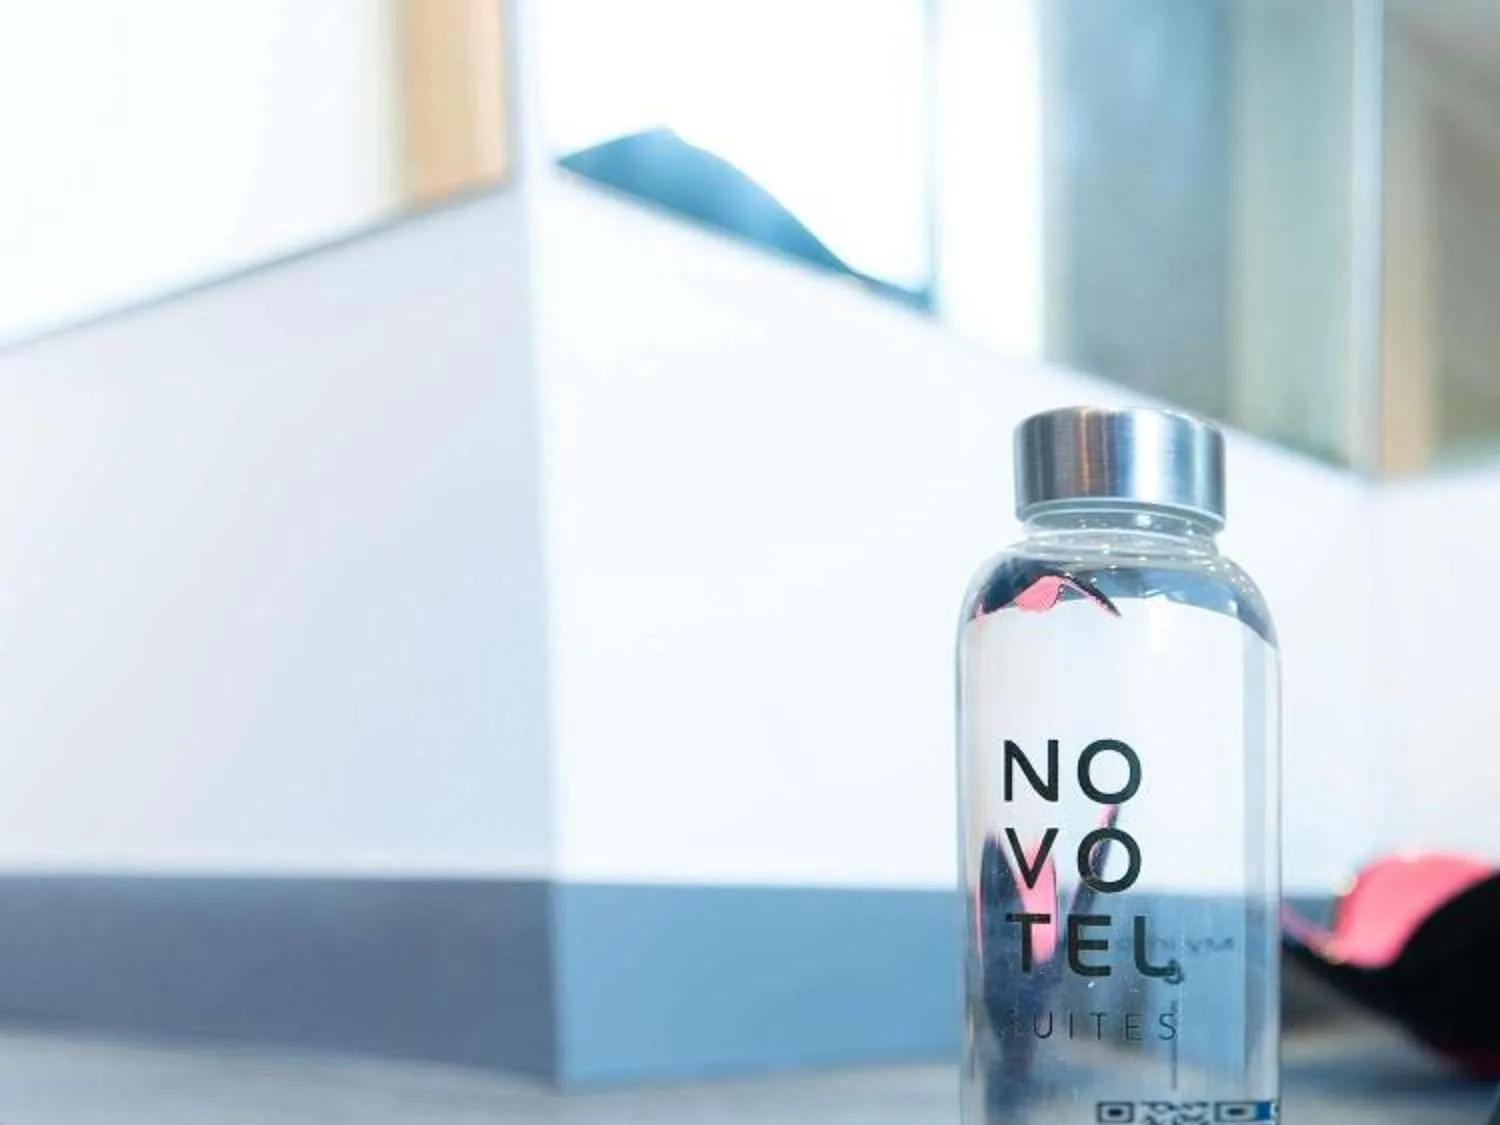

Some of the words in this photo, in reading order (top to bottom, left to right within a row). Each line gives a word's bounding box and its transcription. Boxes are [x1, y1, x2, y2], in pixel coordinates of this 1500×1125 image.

[1003, 738, 1142, 805] NO
[1004, 827, 1142, 893] VO
[1004, 913, 1177, 977] TEL
